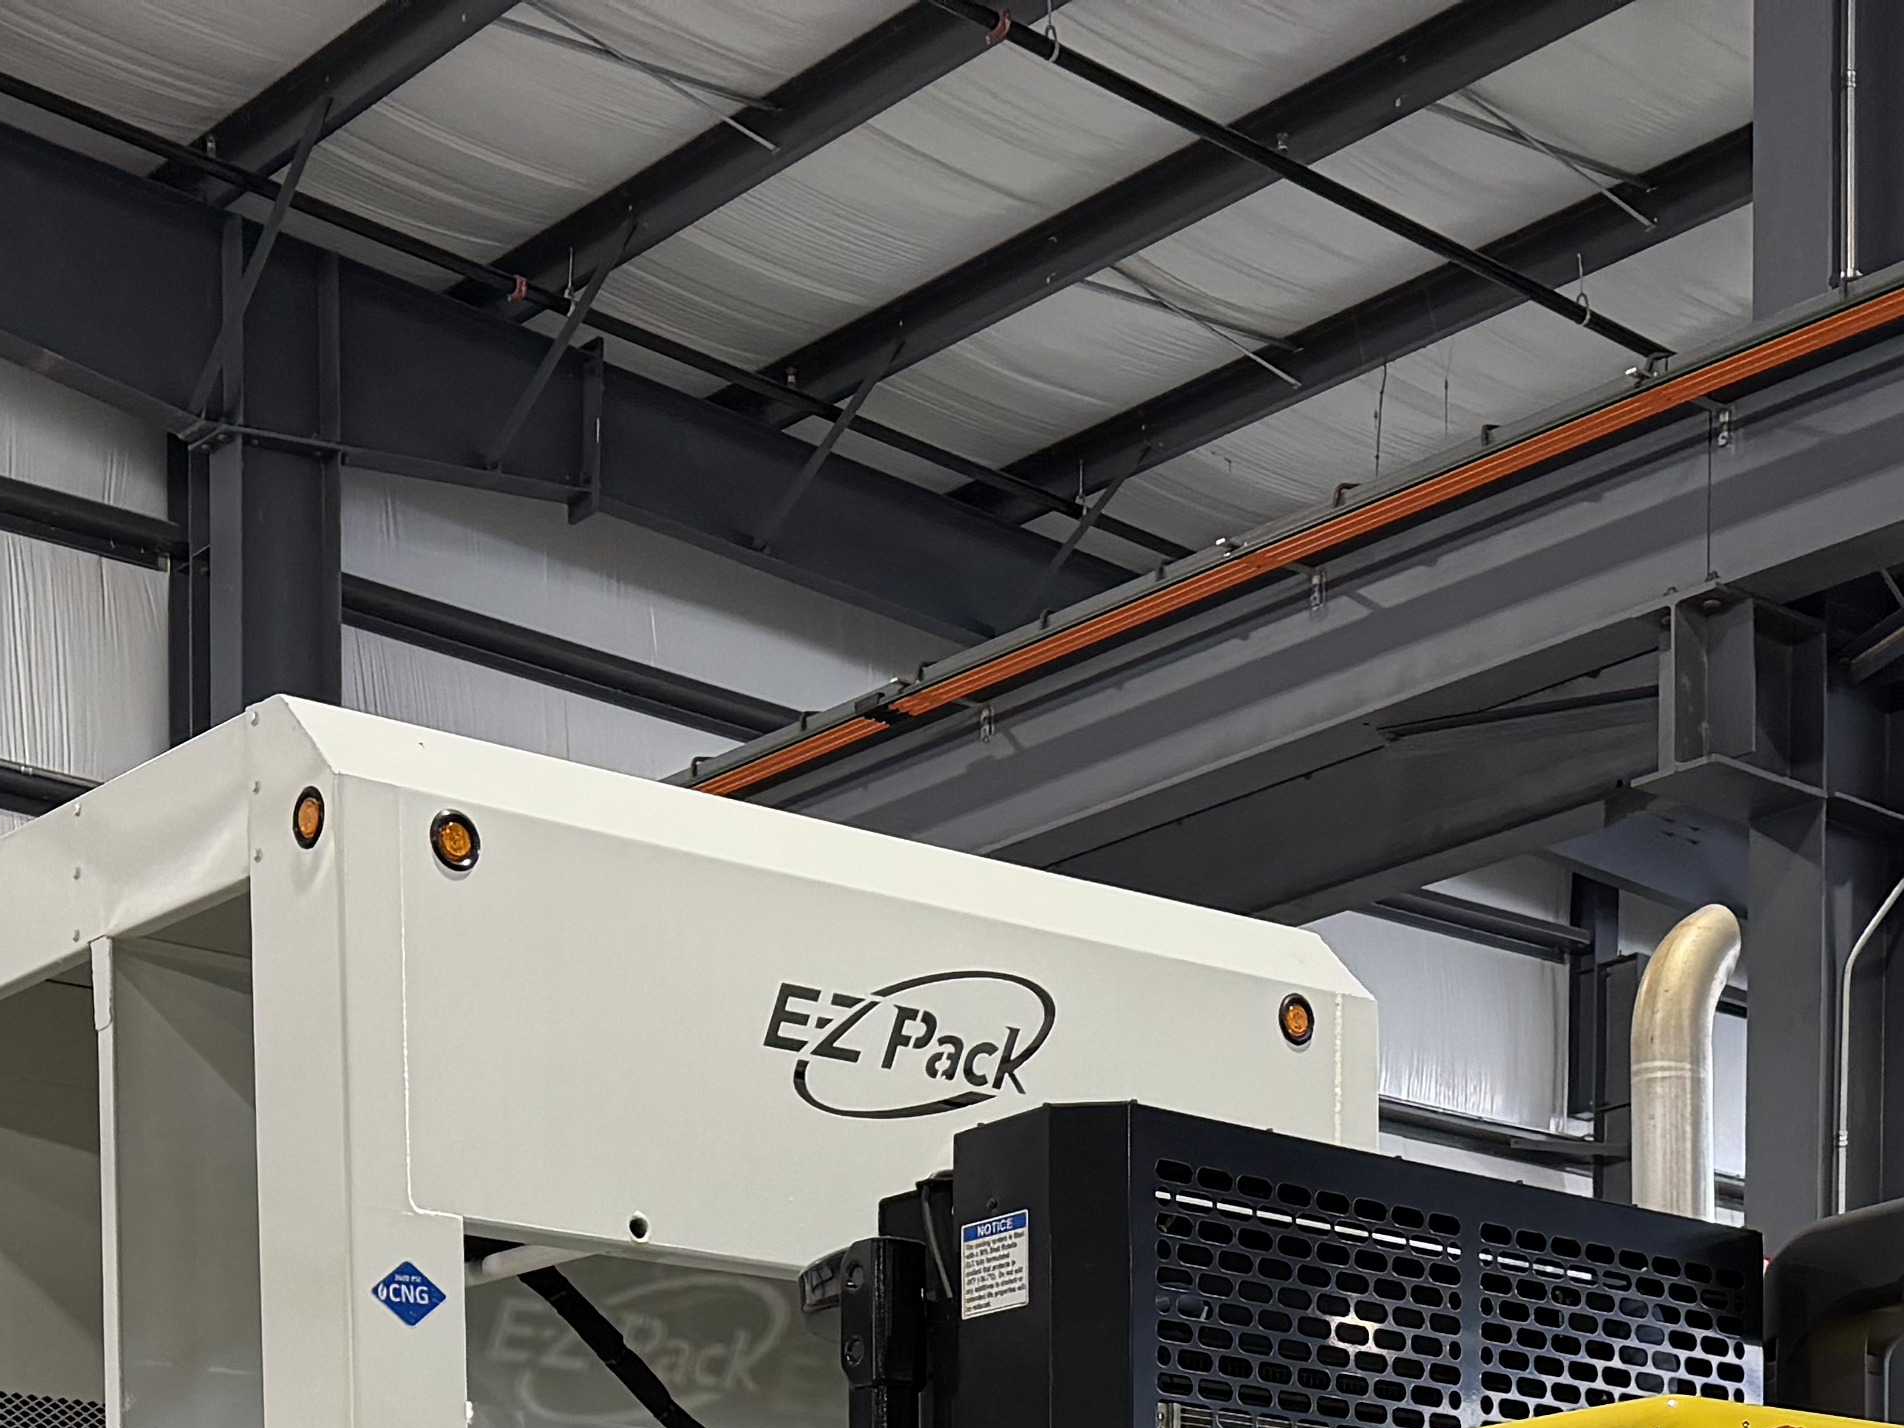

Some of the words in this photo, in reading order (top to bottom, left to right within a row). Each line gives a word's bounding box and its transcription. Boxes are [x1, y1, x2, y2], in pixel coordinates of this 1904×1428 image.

[881, 1004, 1027, 1095] Pack
[977, 1218, 1014, 1238] NOTICE
[389, 1283, 429, 1305] CNG
